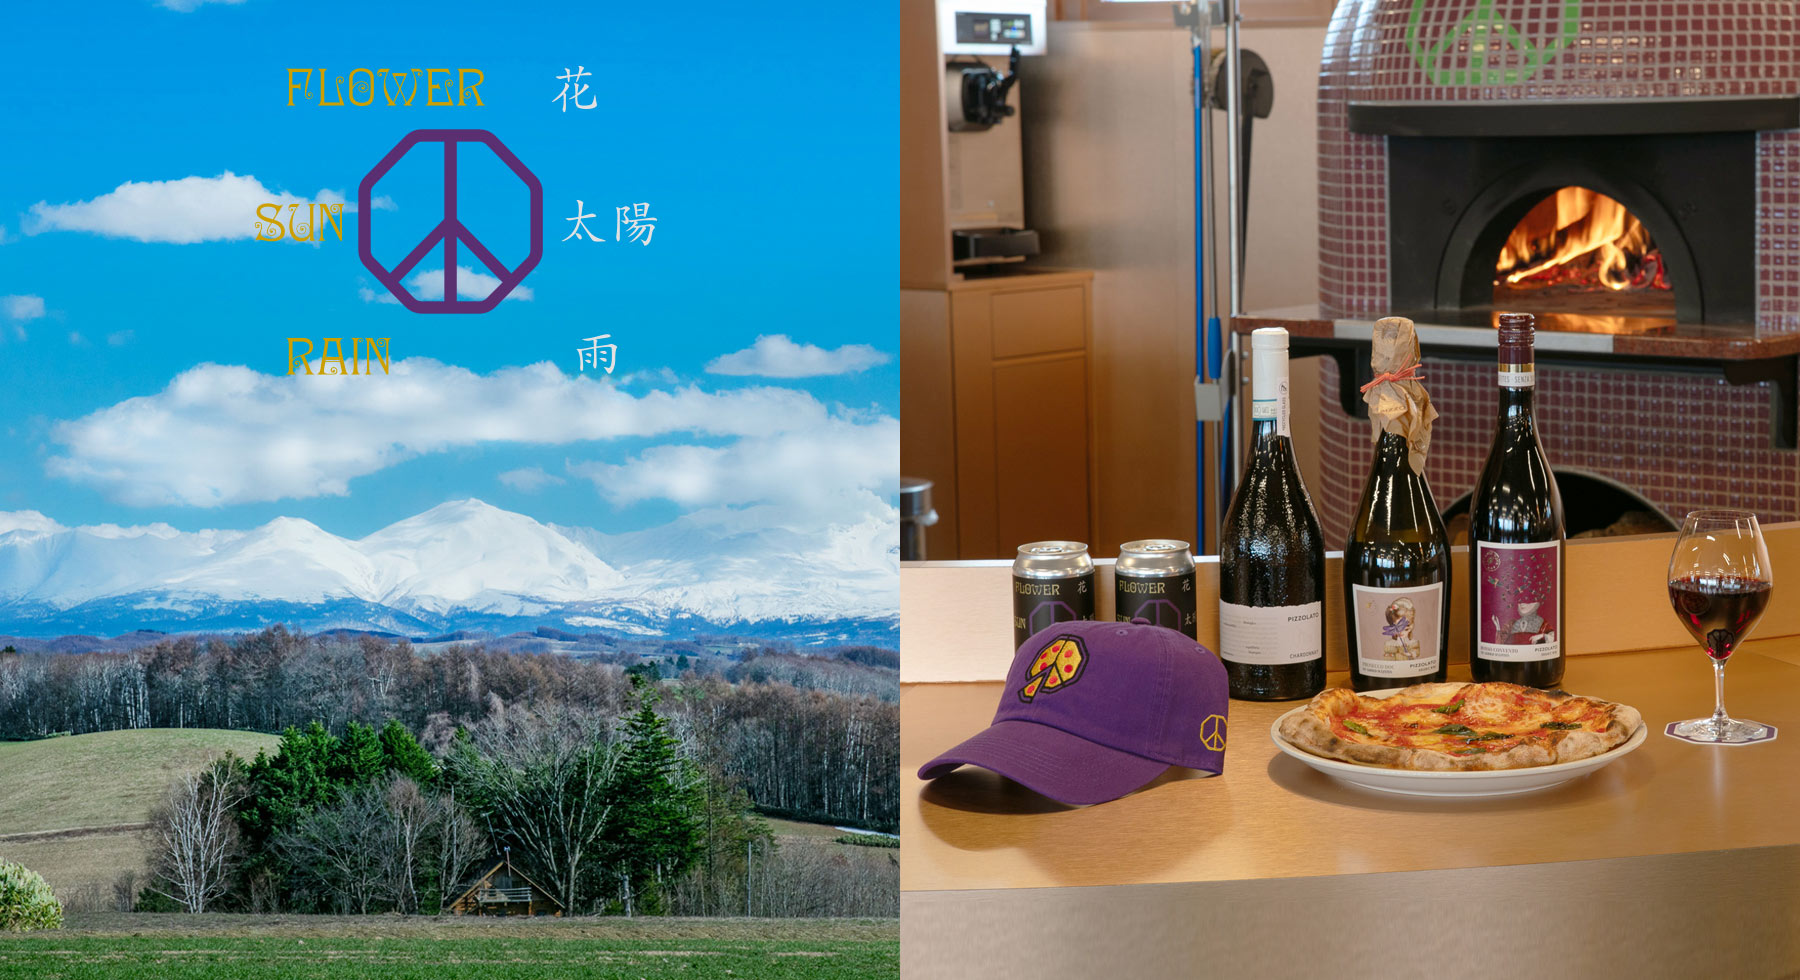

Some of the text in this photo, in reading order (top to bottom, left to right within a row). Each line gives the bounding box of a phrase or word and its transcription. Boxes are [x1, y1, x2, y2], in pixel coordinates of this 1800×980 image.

[1015, 581, 1060, 596] FLOWER
[1077, 580, 1087, 594] 花
[1119, 580, 1165, 594] FLOWER
[1181, 578, 1191, 592] 花
[1287, 612, 1319, 622] PIZZOLATO
[1289, 649, 1319, 659] CHARDONNAY
[1409, 660, 1436, 668] PIZZOLATO
